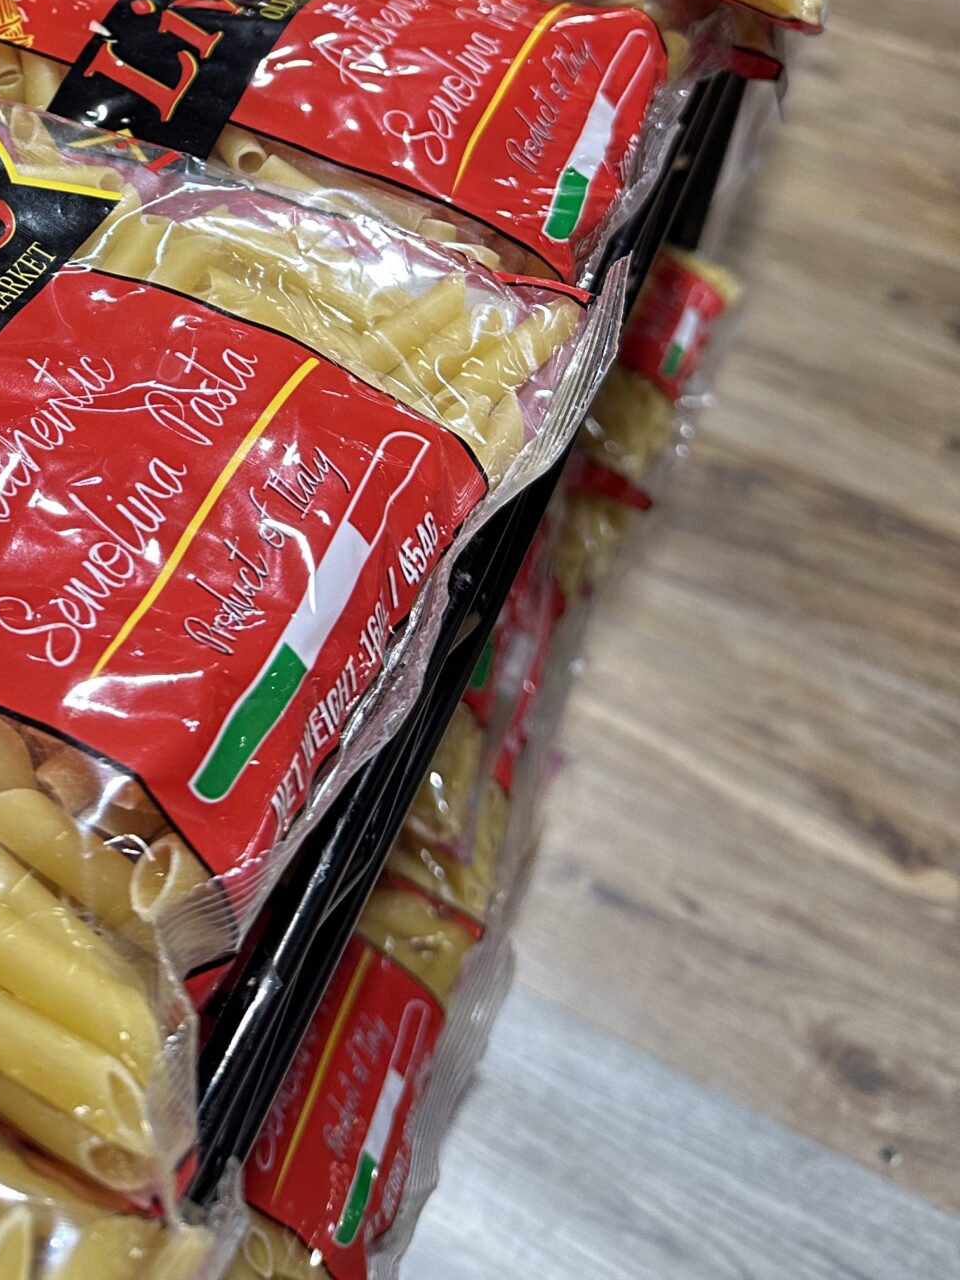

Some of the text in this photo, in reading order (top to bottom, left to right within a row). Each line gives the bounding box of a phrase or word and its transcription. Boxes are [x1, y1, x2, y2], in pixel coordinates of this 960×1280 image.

[383, 31, 502, 166] Semolina
[506, 85, 560, 174] Product
[144, 345, 259, 446] Pasta
[183, 538, 269, 656] Product
[262, 443, 351, 520] Italy
[271, 752, 305, 823] NET
[300, 655, 359, 770] WEIGHT
